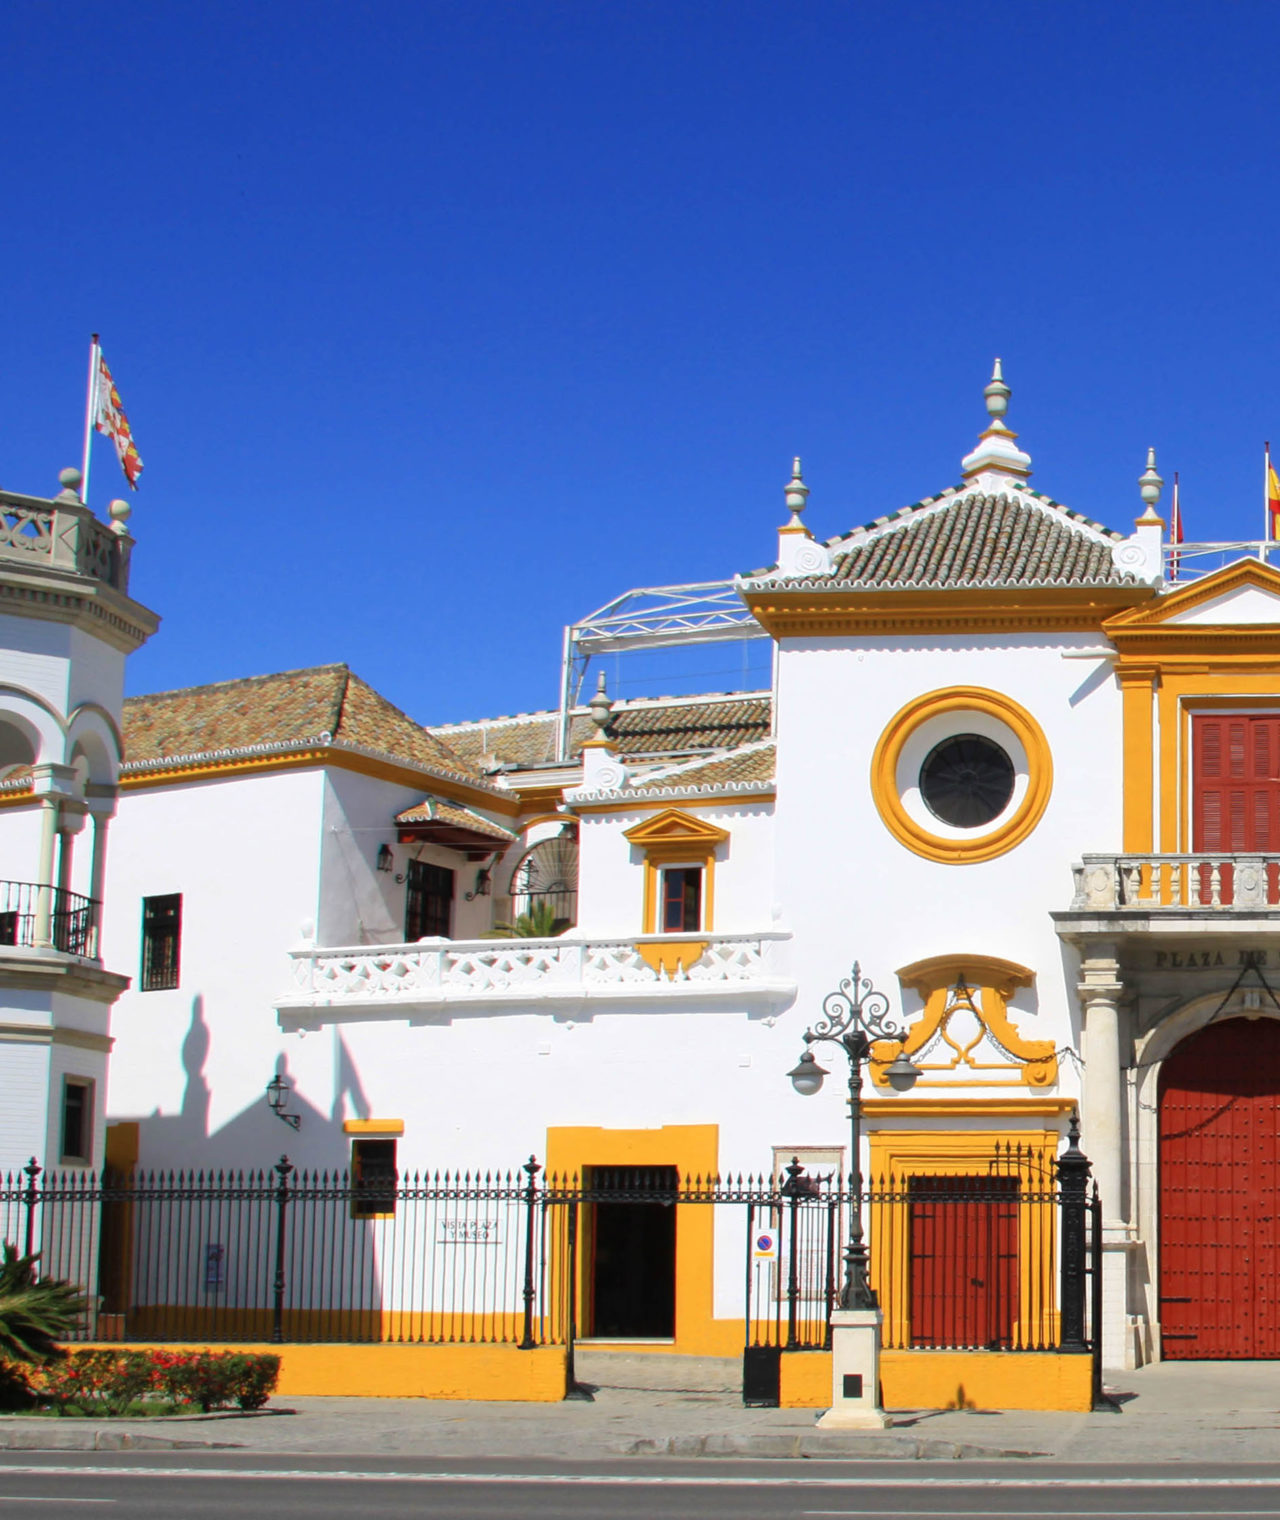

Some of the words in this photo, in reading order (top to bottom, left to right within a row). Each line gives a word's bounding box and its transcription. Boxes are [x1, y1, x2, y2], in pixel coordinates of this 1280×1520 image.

[1155, 951, 1225, 968] PLAZA
[1239, 951, 1267, 967] DE
[441, 1221, 467, 1230] VISITA
[470, 1221, 498, 1230] PLAZA
[459, 1231, 489, 1240] MUSEO
